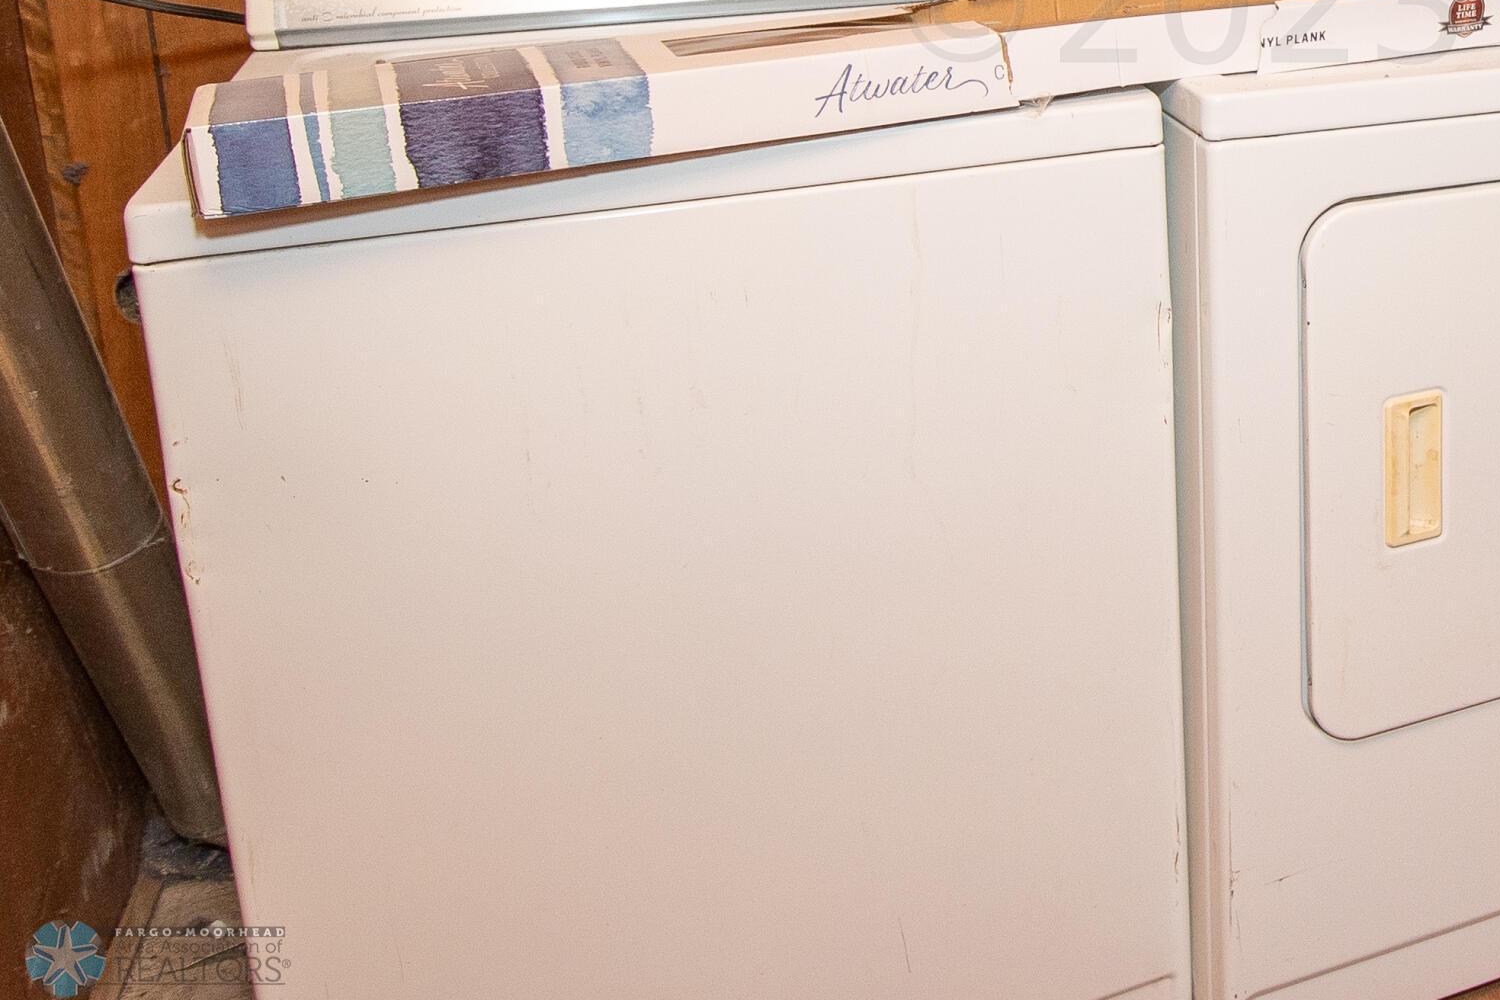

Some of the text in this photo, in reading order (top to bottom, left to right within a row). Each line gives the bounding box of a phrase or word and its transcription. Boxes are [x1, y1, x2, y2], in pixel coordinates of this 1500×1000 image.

[1458, 3, 1476, 12] LIFE
[1456, 10, 1477, 18] TIME
[1448, 24, 1482, 33] WARRANTY
[1286, 30, 1326, 45] PLANK
[814, 63, 988, 118] Atwater
